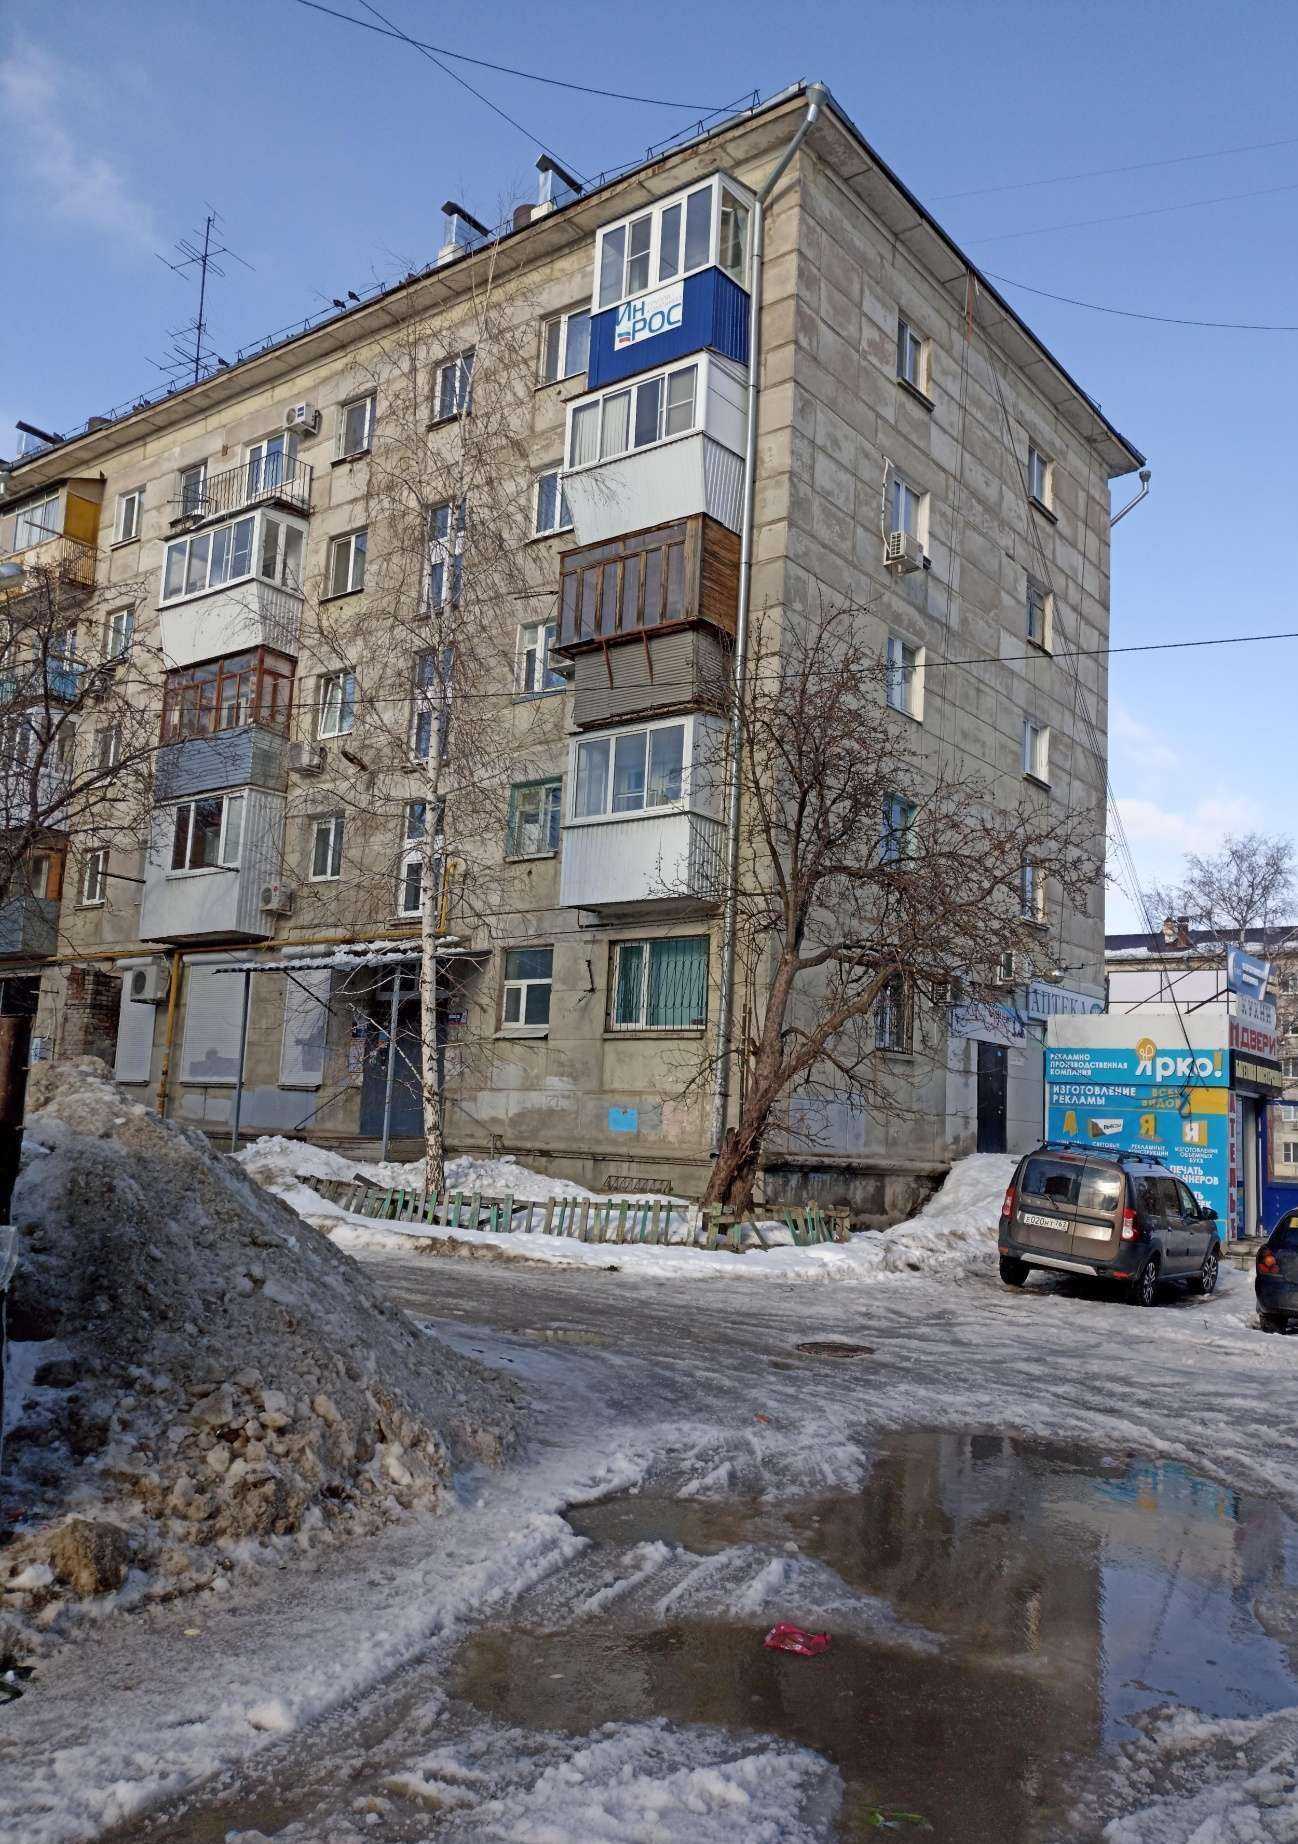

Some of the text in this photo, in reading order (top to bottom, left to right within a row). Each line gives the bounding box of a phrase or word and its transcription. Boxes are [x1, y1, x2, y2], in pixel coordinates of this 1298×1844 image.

[632, 302, 682, 341] РОС
[1240, 1027, 1276, 1057] ДВЕРИ
[1053, 1085, 1137, 1097] ИЗГОТОВЛЕНИЕ
[1053, 1094, 1105, 1106] РЕКЛАМЫ
